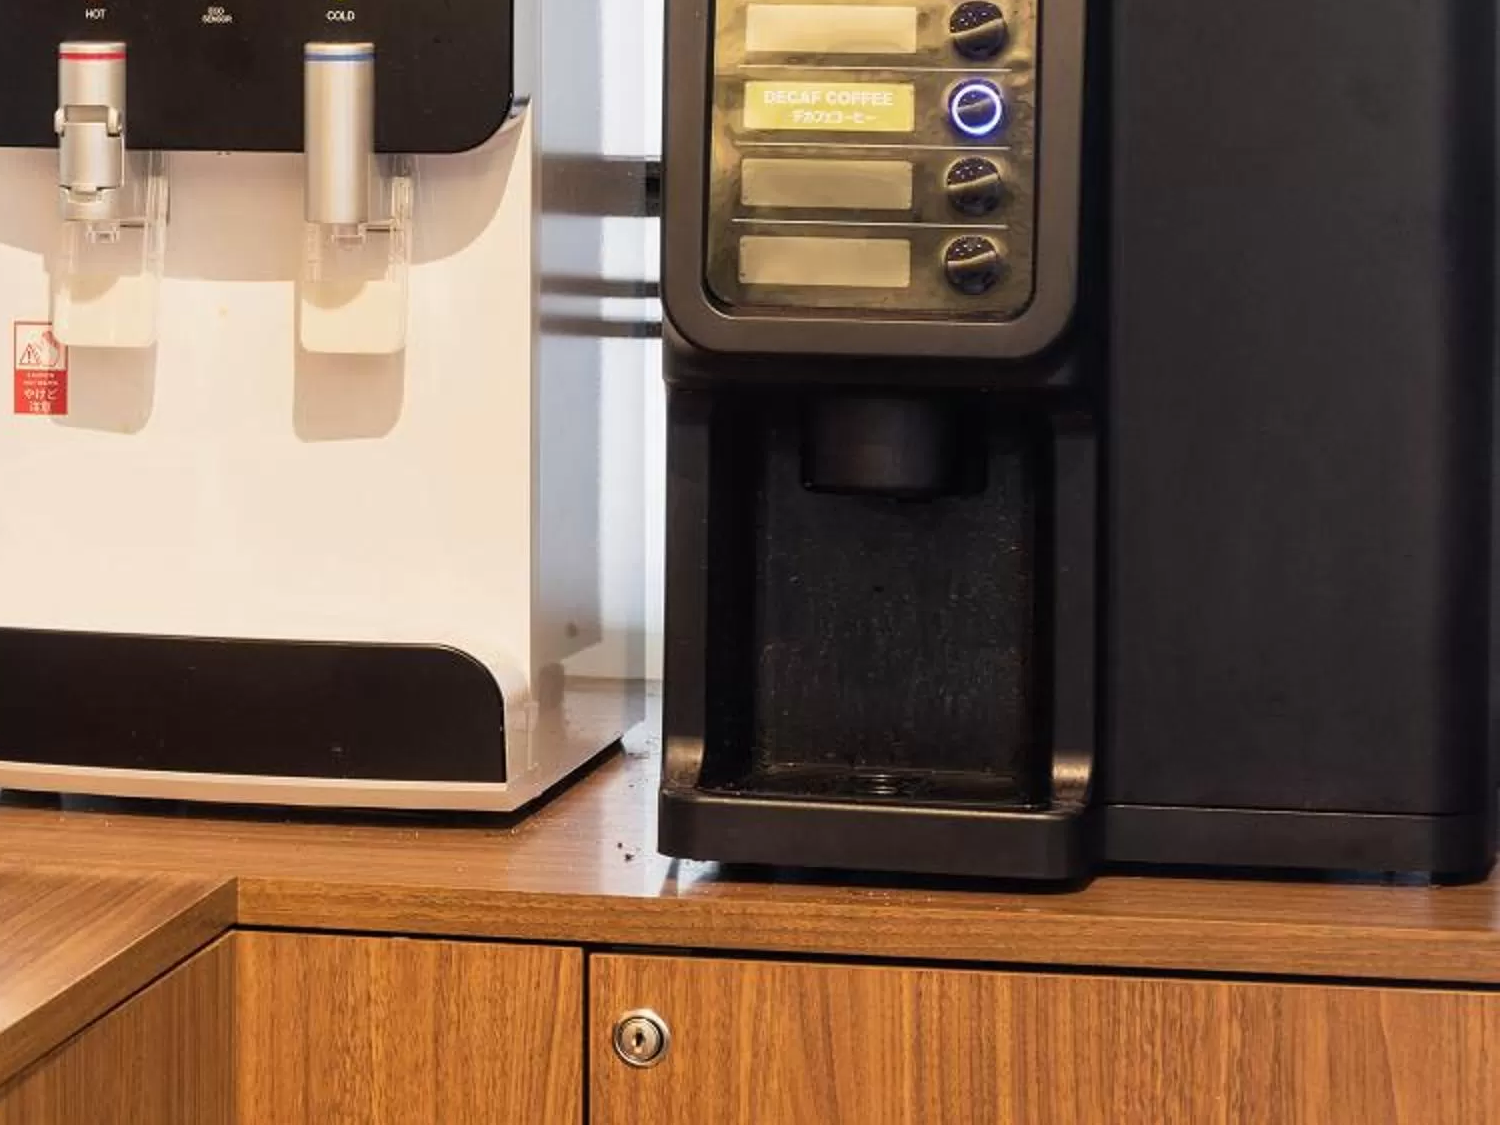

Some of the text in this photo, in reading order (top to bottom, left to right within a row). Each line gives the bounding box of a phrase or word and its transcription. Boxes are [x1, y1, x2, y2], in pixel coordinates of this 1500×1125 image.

[85, 8, 107, 20] HOT
[326, 10, 355, 22] COLD
[763, 90, 895, 106] DECAF COFFEE
